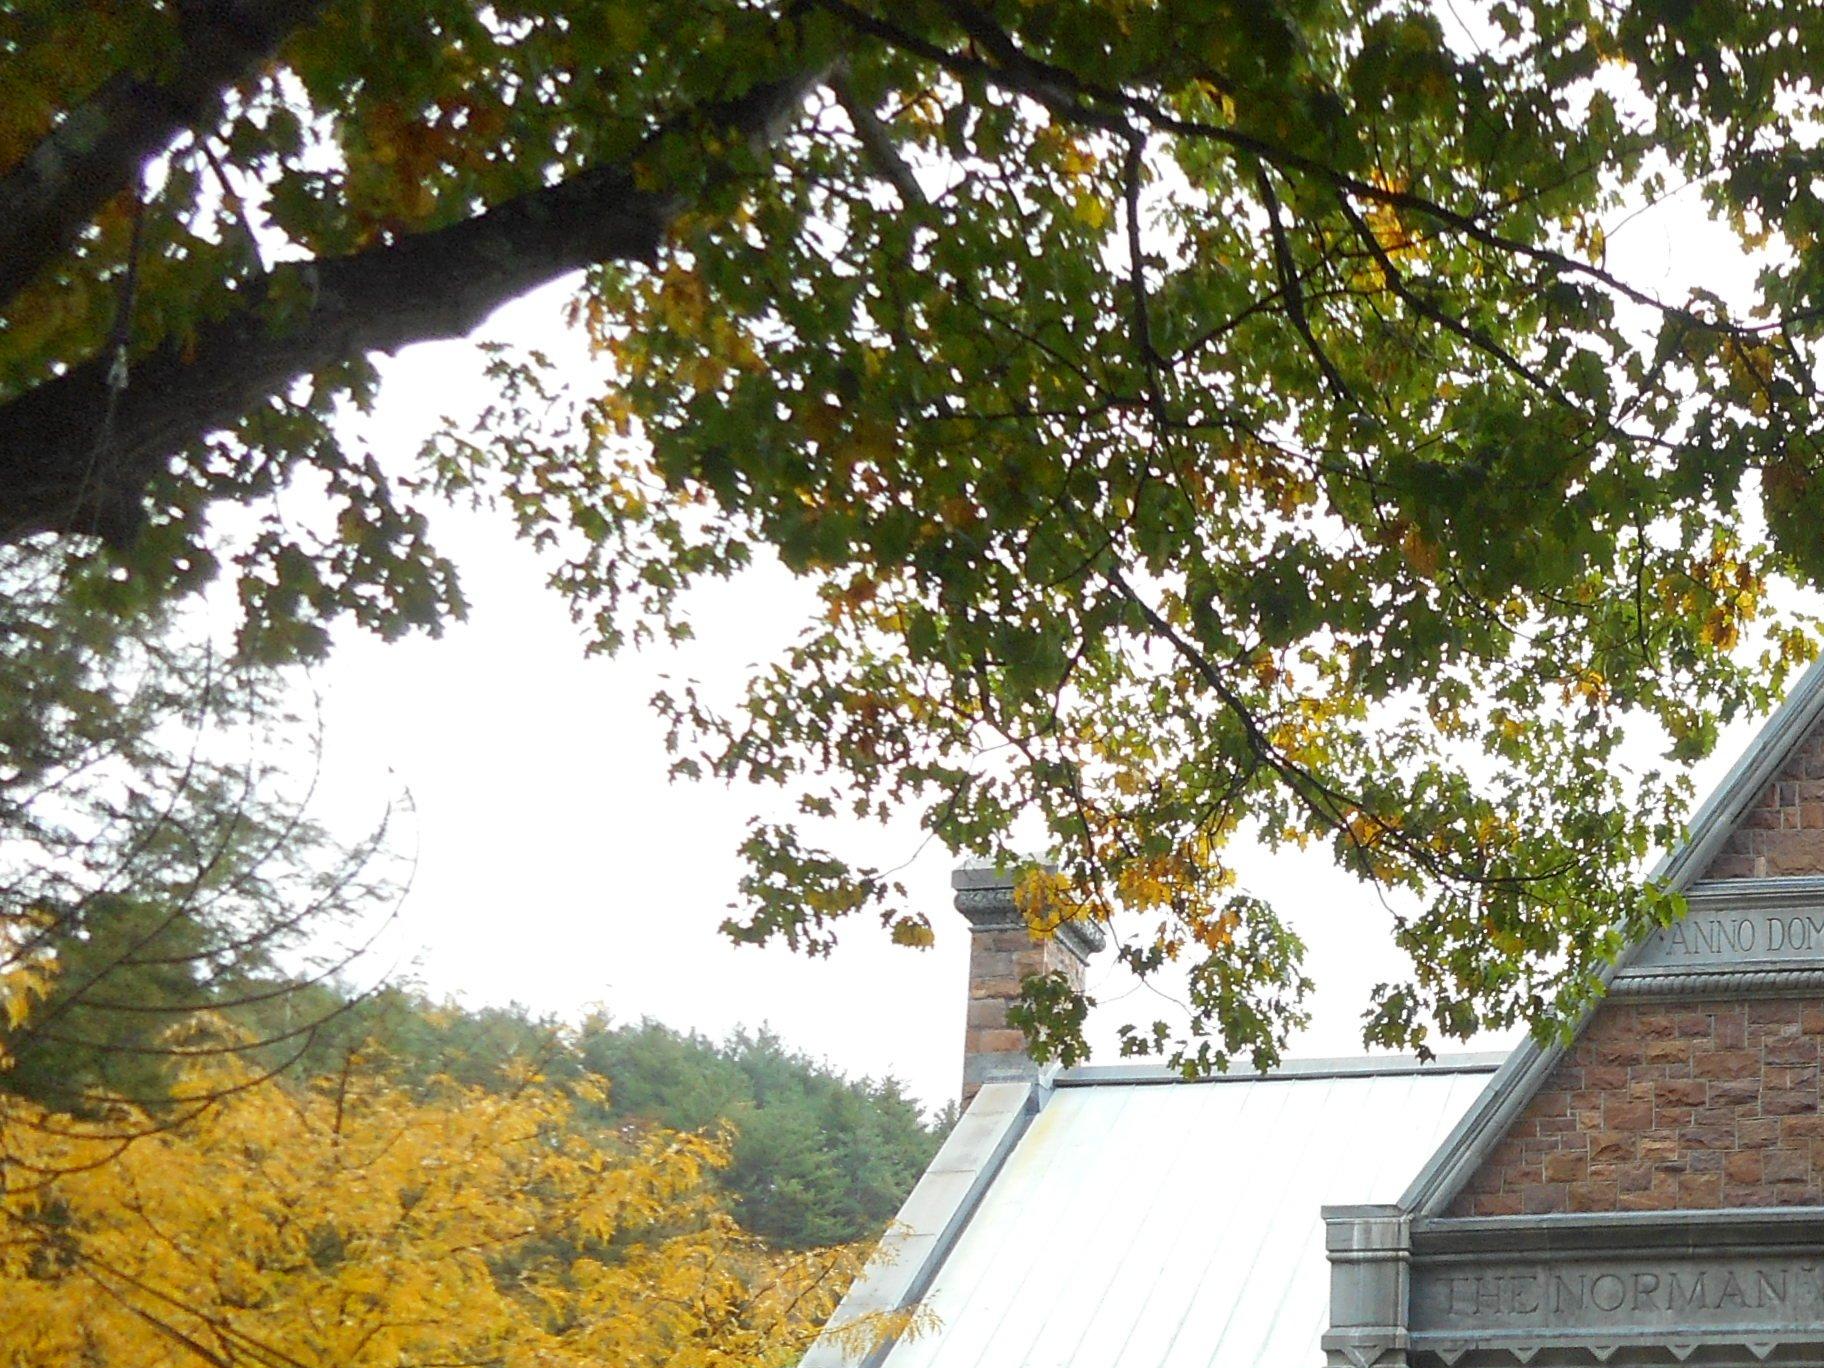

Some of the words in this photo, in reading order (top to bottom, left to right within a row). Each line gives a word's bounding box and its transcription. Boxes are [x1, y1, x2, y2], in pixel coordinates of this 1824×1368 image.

[1666, 918, 1756, 955] ANNO
[1436, 1275, 1538, 1316] THE
[1552, 1268, 1788, 1314] NORMAN
